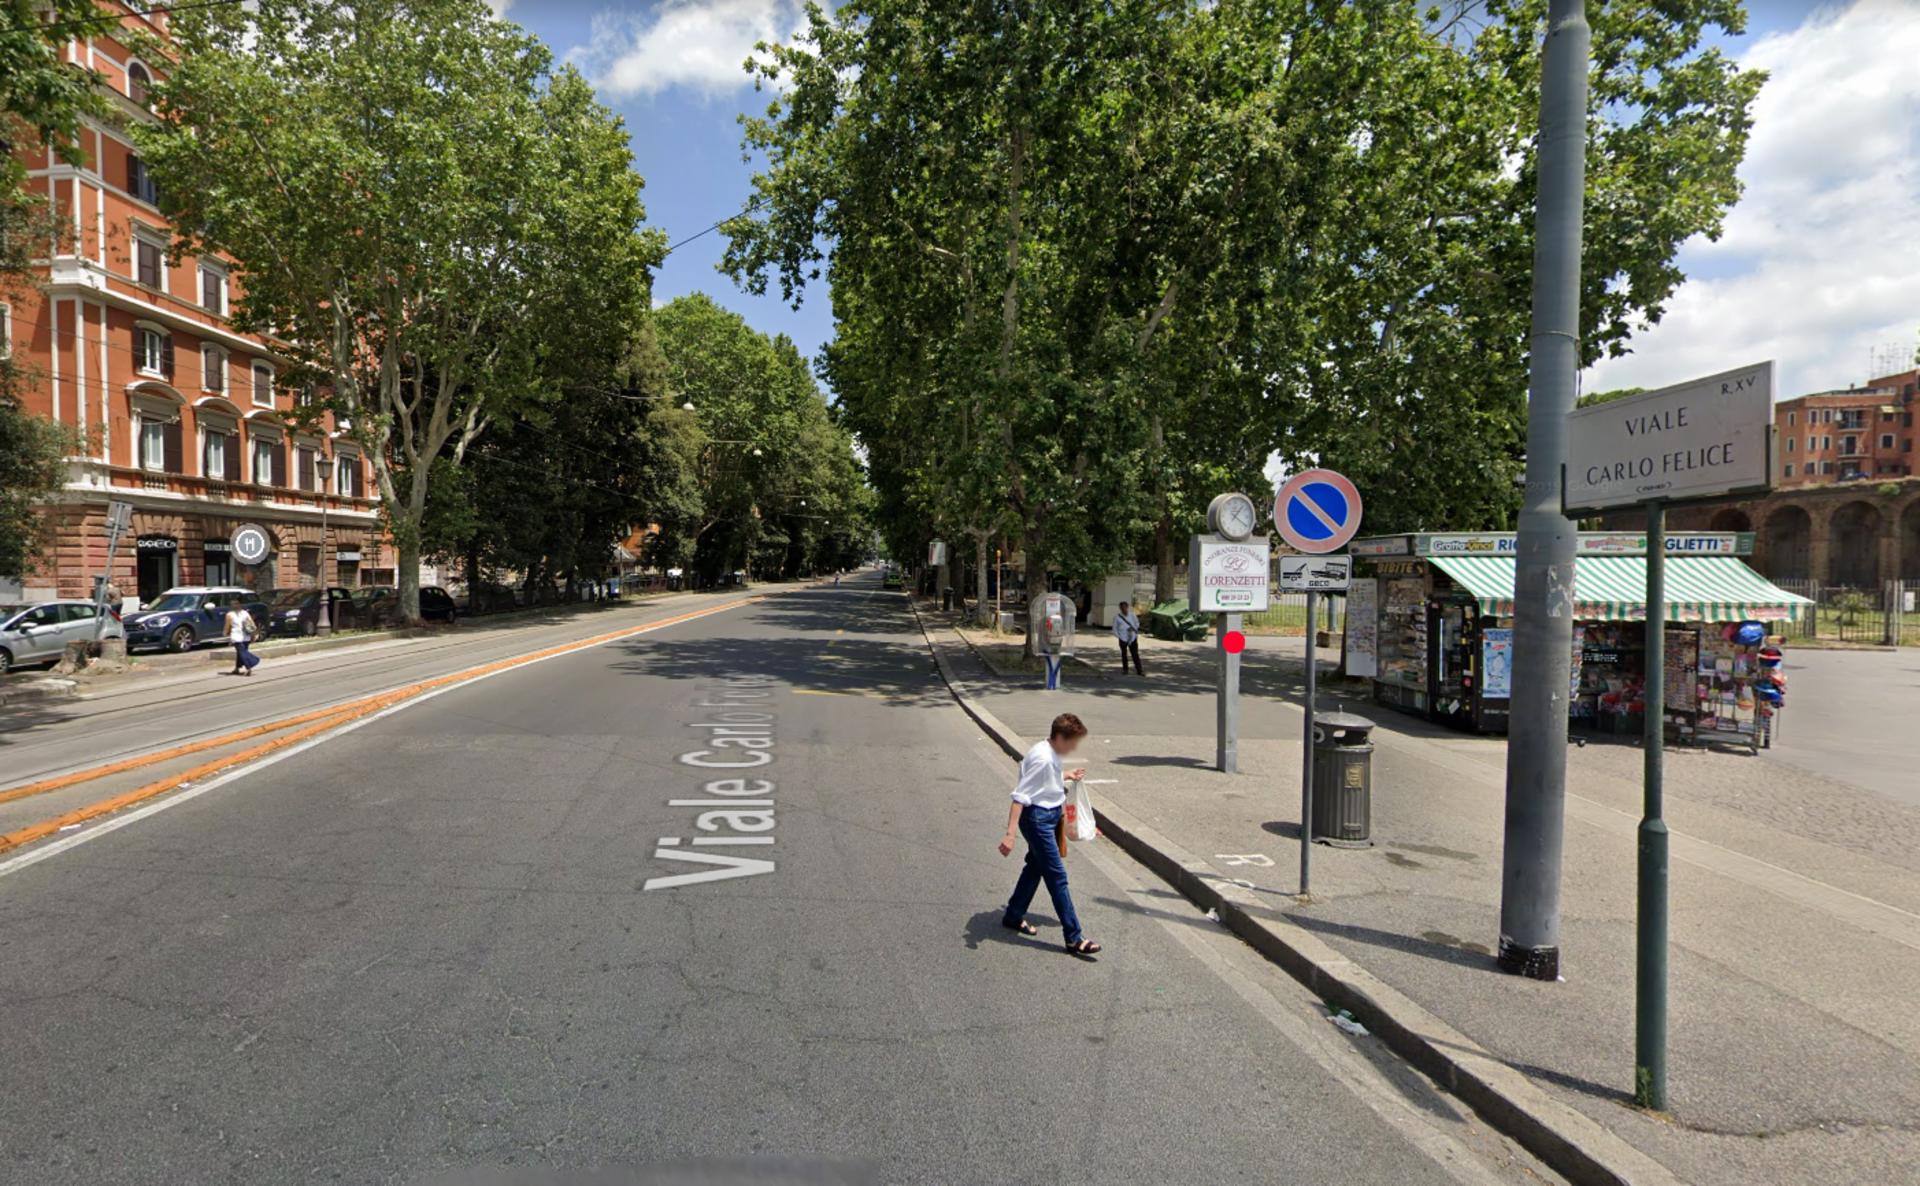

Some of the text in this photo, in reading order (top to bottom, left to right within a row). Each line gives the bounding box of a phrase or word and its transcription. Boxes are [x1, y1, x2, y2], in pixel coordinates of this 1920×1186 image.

[1625, 406, 1688, 436] VIALE
[1586, 443, 1735, 486] CARLO FELICE
[1665, 538, 1718, 551] GLIETTI
[1204, 575, 1265, 586] LORENZETTI
